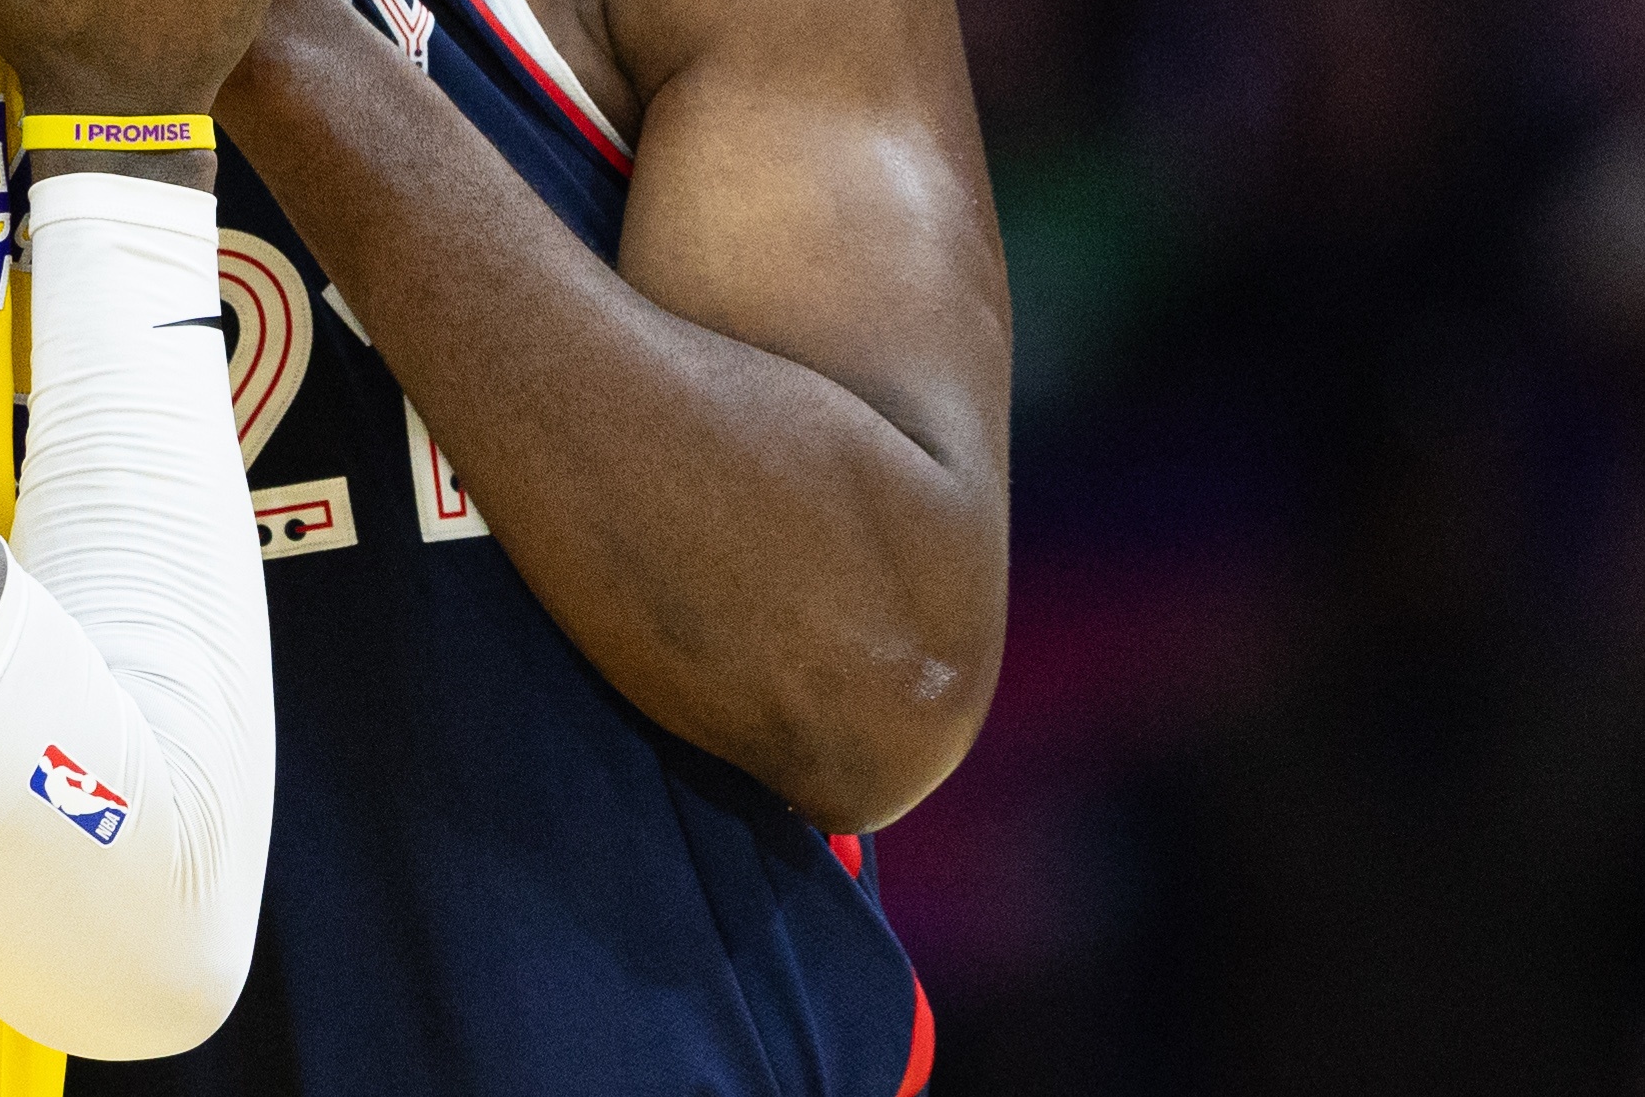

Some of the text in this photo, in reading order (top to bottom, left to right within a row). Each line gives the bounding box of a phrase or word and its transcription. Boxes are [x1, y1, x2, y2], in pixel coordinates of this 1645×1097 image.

[74, 122, 192, 143] I PROMISE
[95, 810, 121, 841] NBA
